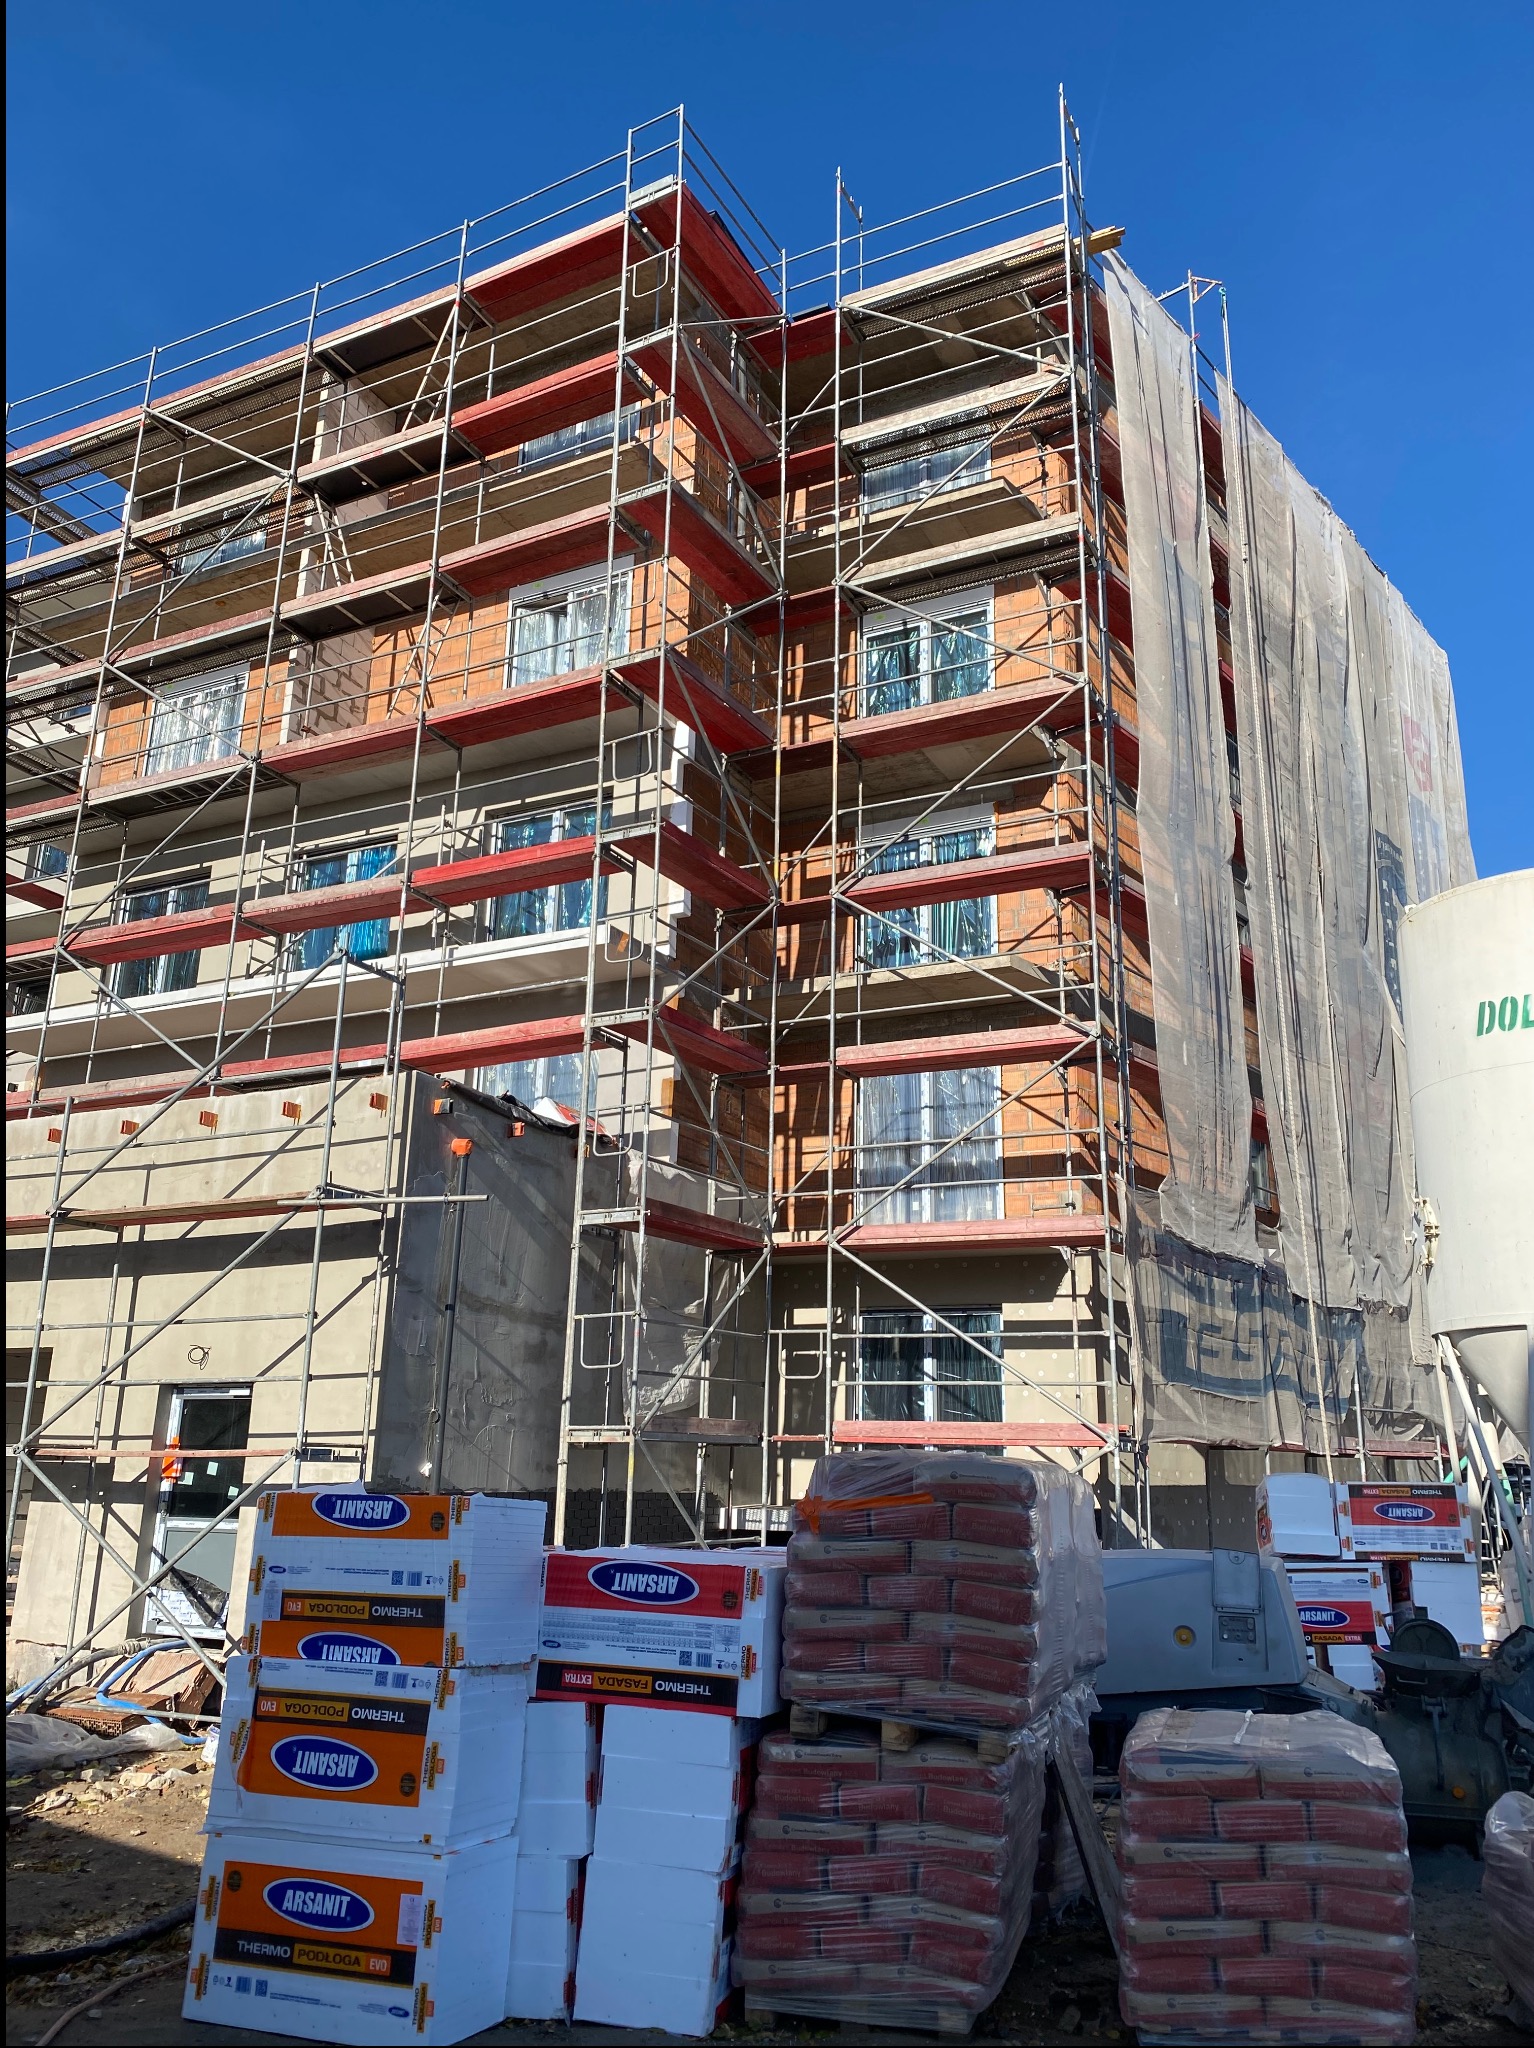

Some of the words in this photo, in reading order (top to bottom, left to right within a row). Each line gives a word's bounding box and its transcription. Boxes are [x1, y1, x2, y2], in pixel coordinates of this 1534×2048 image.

[333, 1499, 393, 1520] ARSANIT
[1388, 1507, 1424, 1518] ARSANIT
[611, 1572, 679, 1595] ARSANIT
[287, 1601, 302, 1612] EVO
[309, 1602, 365, 1615] PODŁOGA
[372, 1605, 423, 1618] THERMO
[1301, 1611, 1336, 1622] ARSANIT
[322, 1644, 382, 1664] ARSANIT
[434, 1669, 443, 1703] THERMO
[565, 1672, 592, 1685] EXTRA
[598, 1675, 649, 1690] FASADA
[654, 1680, 711, 1696] THERMO
[261, 1701, 277, 1712] EVO
[284, 1702, 344, 1717] PODŁOGA
[352, 1707, 406, 1723] THERMO
[292, 1750, 359, 1778] ARSANIT
[422, 1747, 431, 1784] THERMO
[282, 1889, 351, 1918] ARSANIT
[237, 1940, 291, 1958] THERMO
[298, 1948, 361, 1968] PODŁOGA
[370, 1958, 387, 1972] EVO
